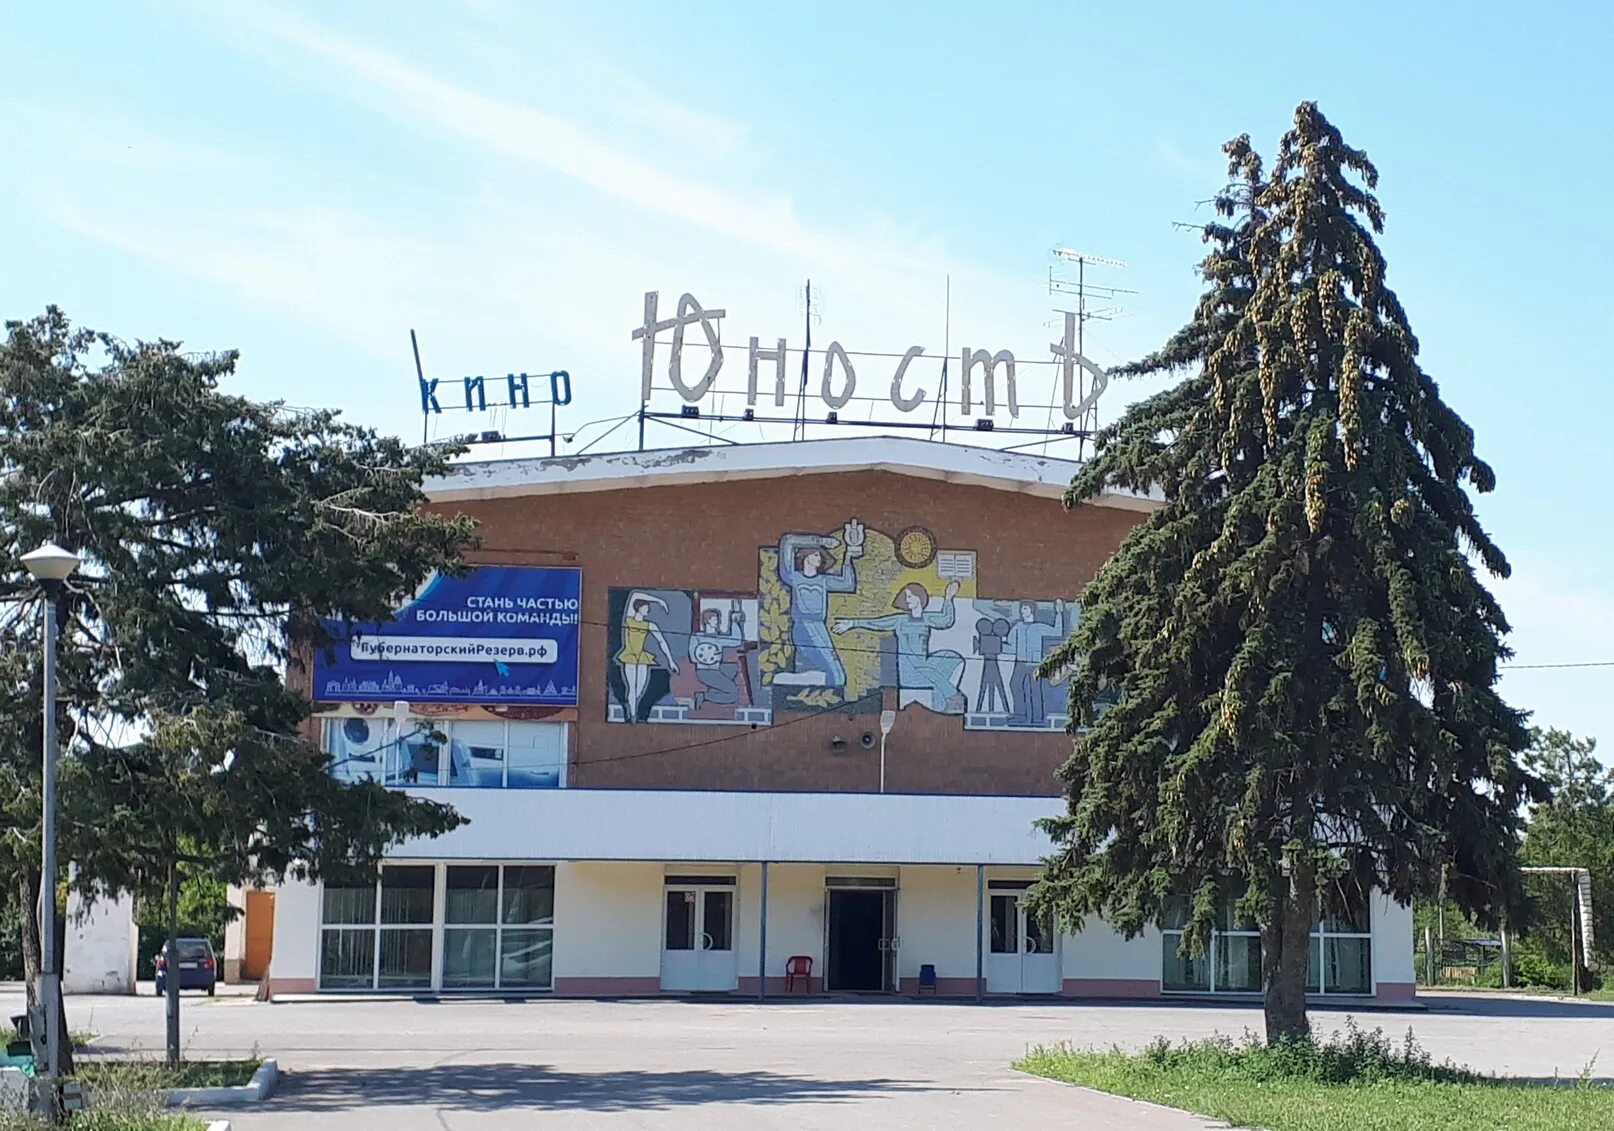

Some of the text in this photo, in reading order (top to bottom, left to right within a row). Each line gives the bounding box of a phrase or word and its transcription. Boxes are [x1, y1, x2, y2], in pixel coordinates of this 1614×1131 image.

[632, 291, 1108, 419] Юность
[467, 597, 578, 610] СТАНЬ ЧАСТЬЮ
[416, 609, 578, 626] БОЛЬШОЙ КОМАНДЫ!
